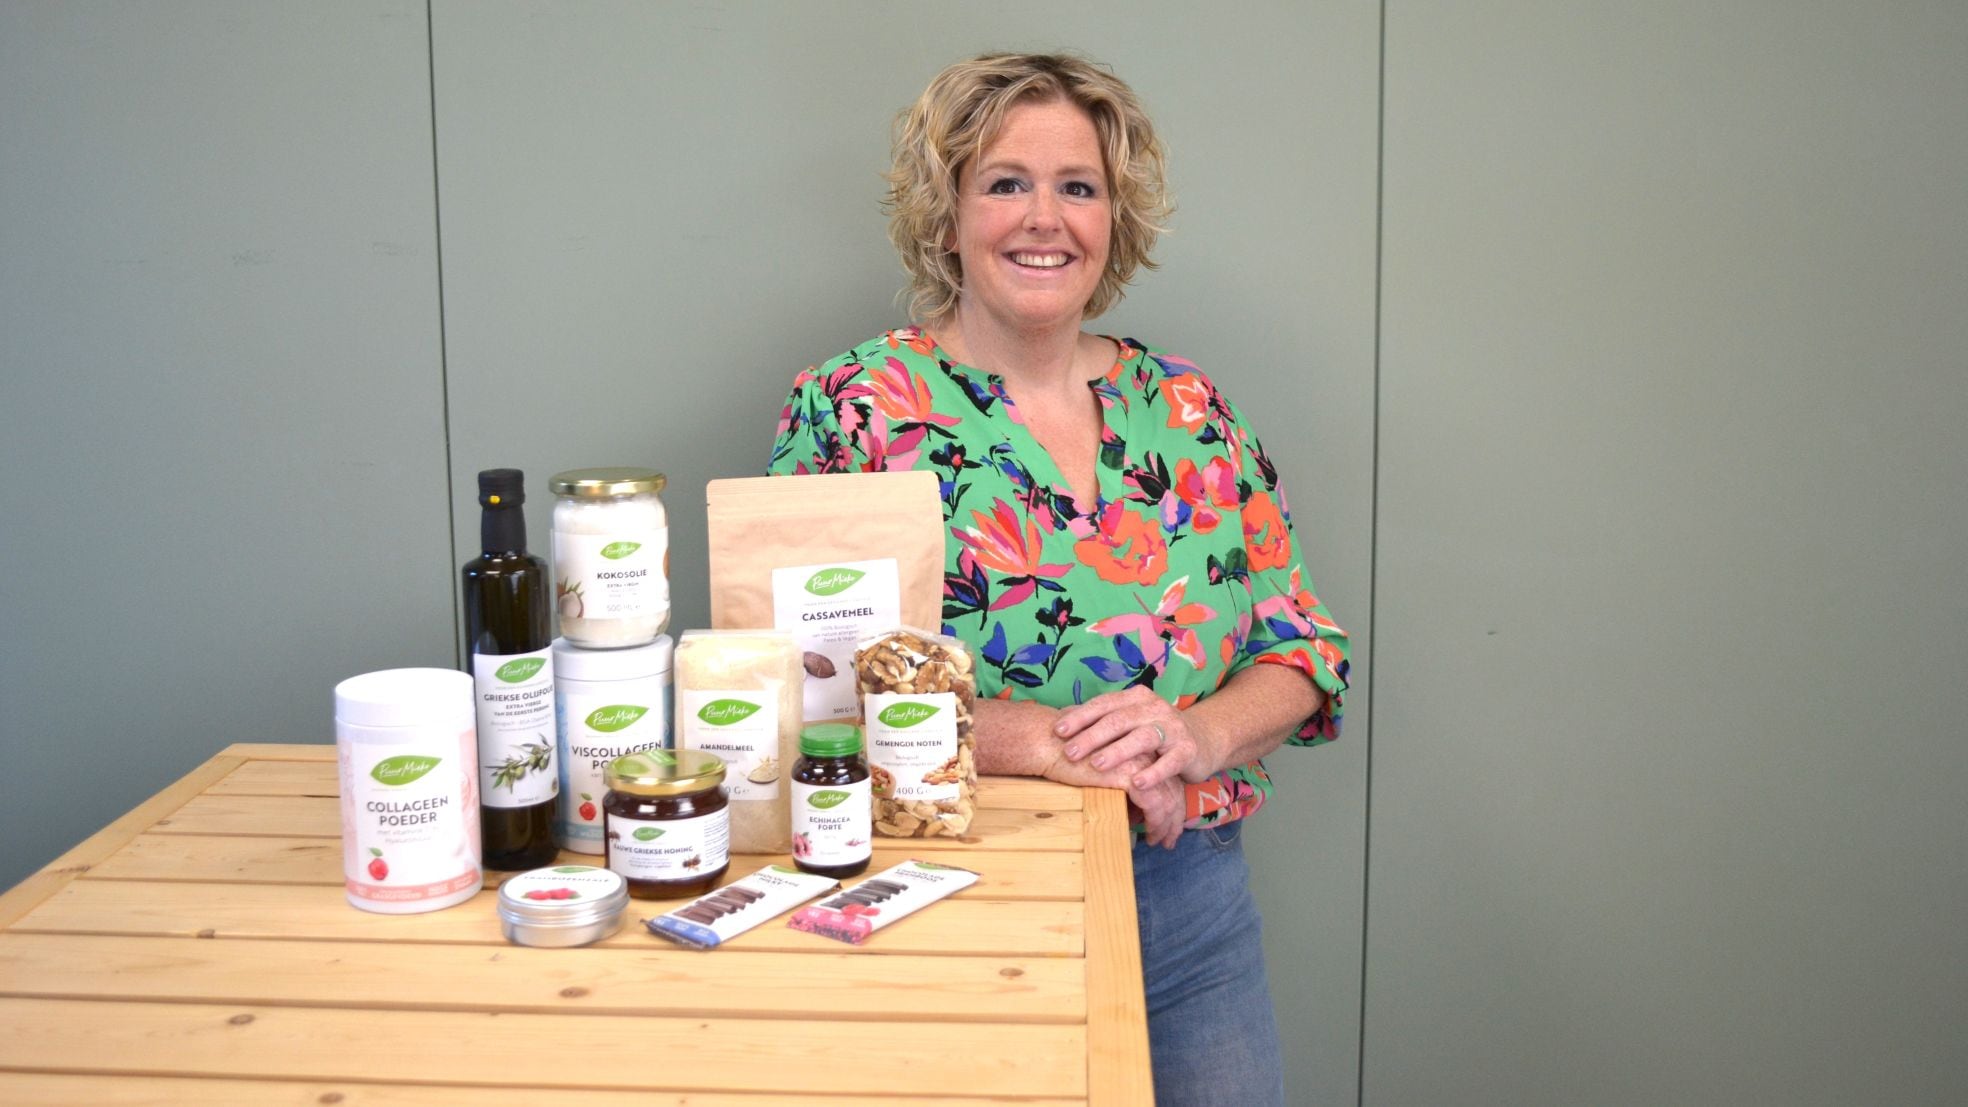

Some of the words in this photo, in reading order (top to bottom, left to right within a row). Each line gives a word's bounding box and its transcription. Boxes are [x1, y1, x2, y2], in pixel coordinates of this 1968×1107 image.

[597, 569, 647, 580] KOKOSOLIE
[802, 607, 874, 622] CASSAVEMEEL
[484, 693, 521, 702] GRIEKSE
[706, 704, 725, 719] Puur
[724, 704, 749, 719] Mieke
[886, 708, 905, 722] Puur
[904, 706, 928, 721] Mieke
[593, 711, 614, 727] Puur
[612, 710, 639, 725] Mieke
[700, 743, 754, 752] AMANDELMEEL
[896, 787, 914, 795] 400
[917, 787, 924, 795] G
[367, 795, 448, 813] COLLAGEEN
[379, 811, 437, 826] POEDER
[809, 816, 851, 824] ECHINACEA
[633, 847, 663, 855] GRIEKSE
[664, 845, 694, 855] HONING
